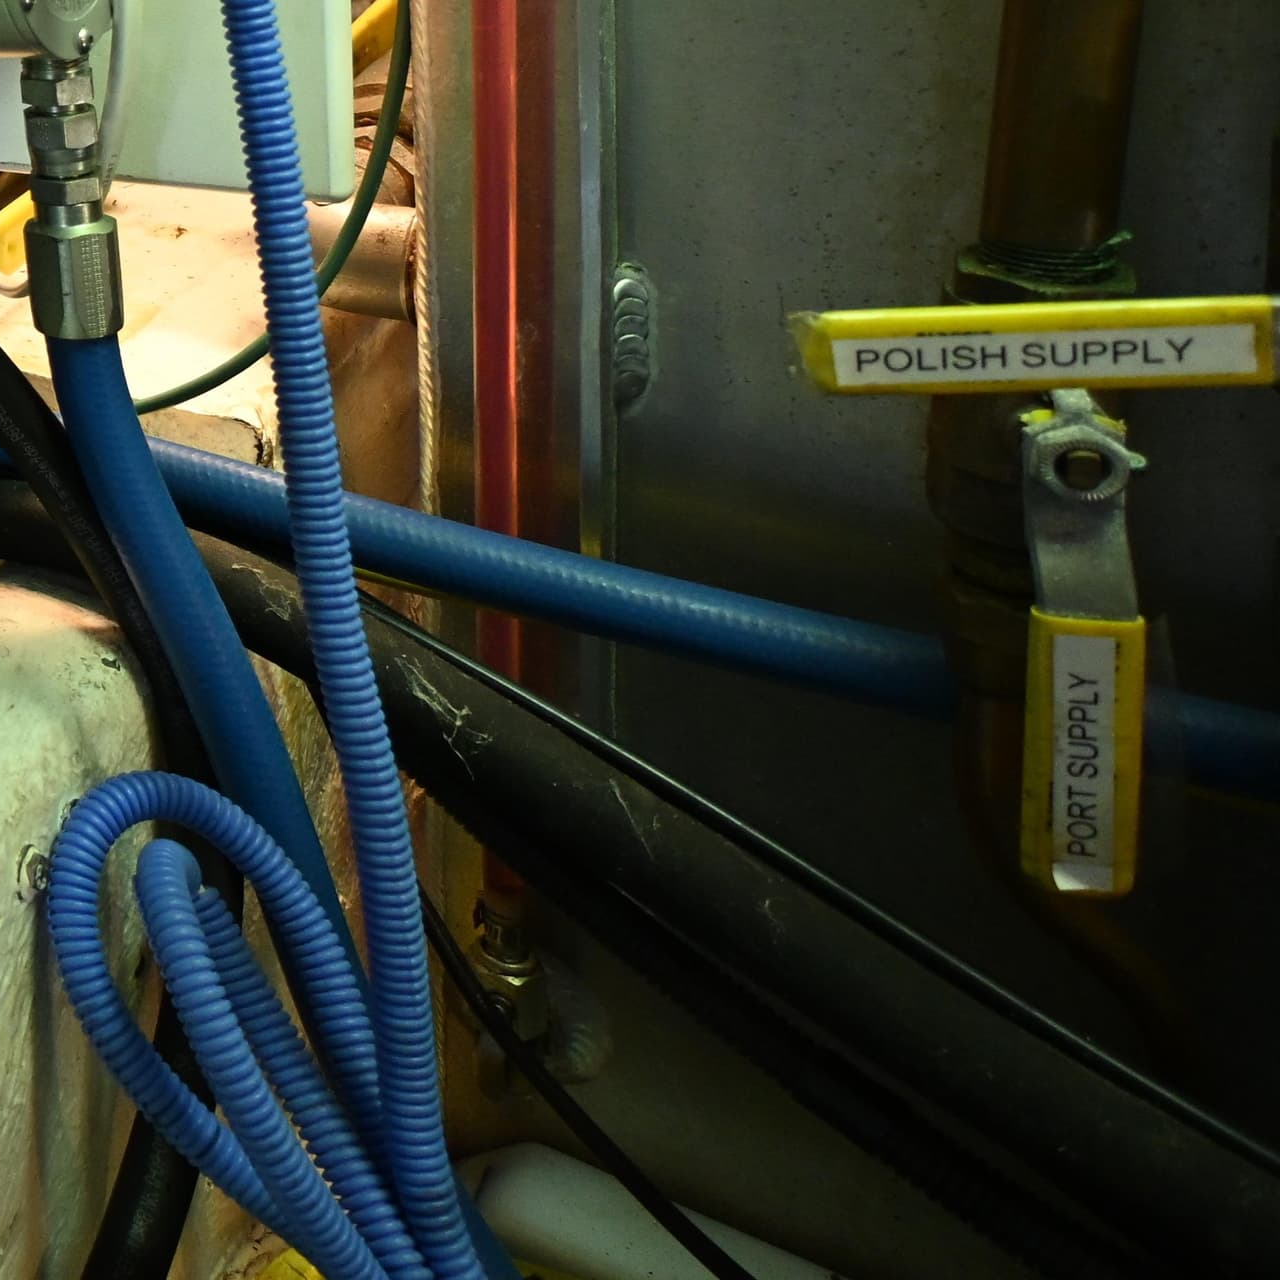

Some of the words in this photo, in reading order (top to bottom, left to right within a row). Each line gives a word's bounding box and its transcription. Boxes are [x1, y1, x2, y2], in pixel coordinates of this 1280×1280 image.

[855, 343, 1008, 374] POLISH
[1019, 336, 1195, 369] SUPPLY
[1066, 672, 1100, 780] SUPPLY
[1066, 784, 1098, 858] PORT
